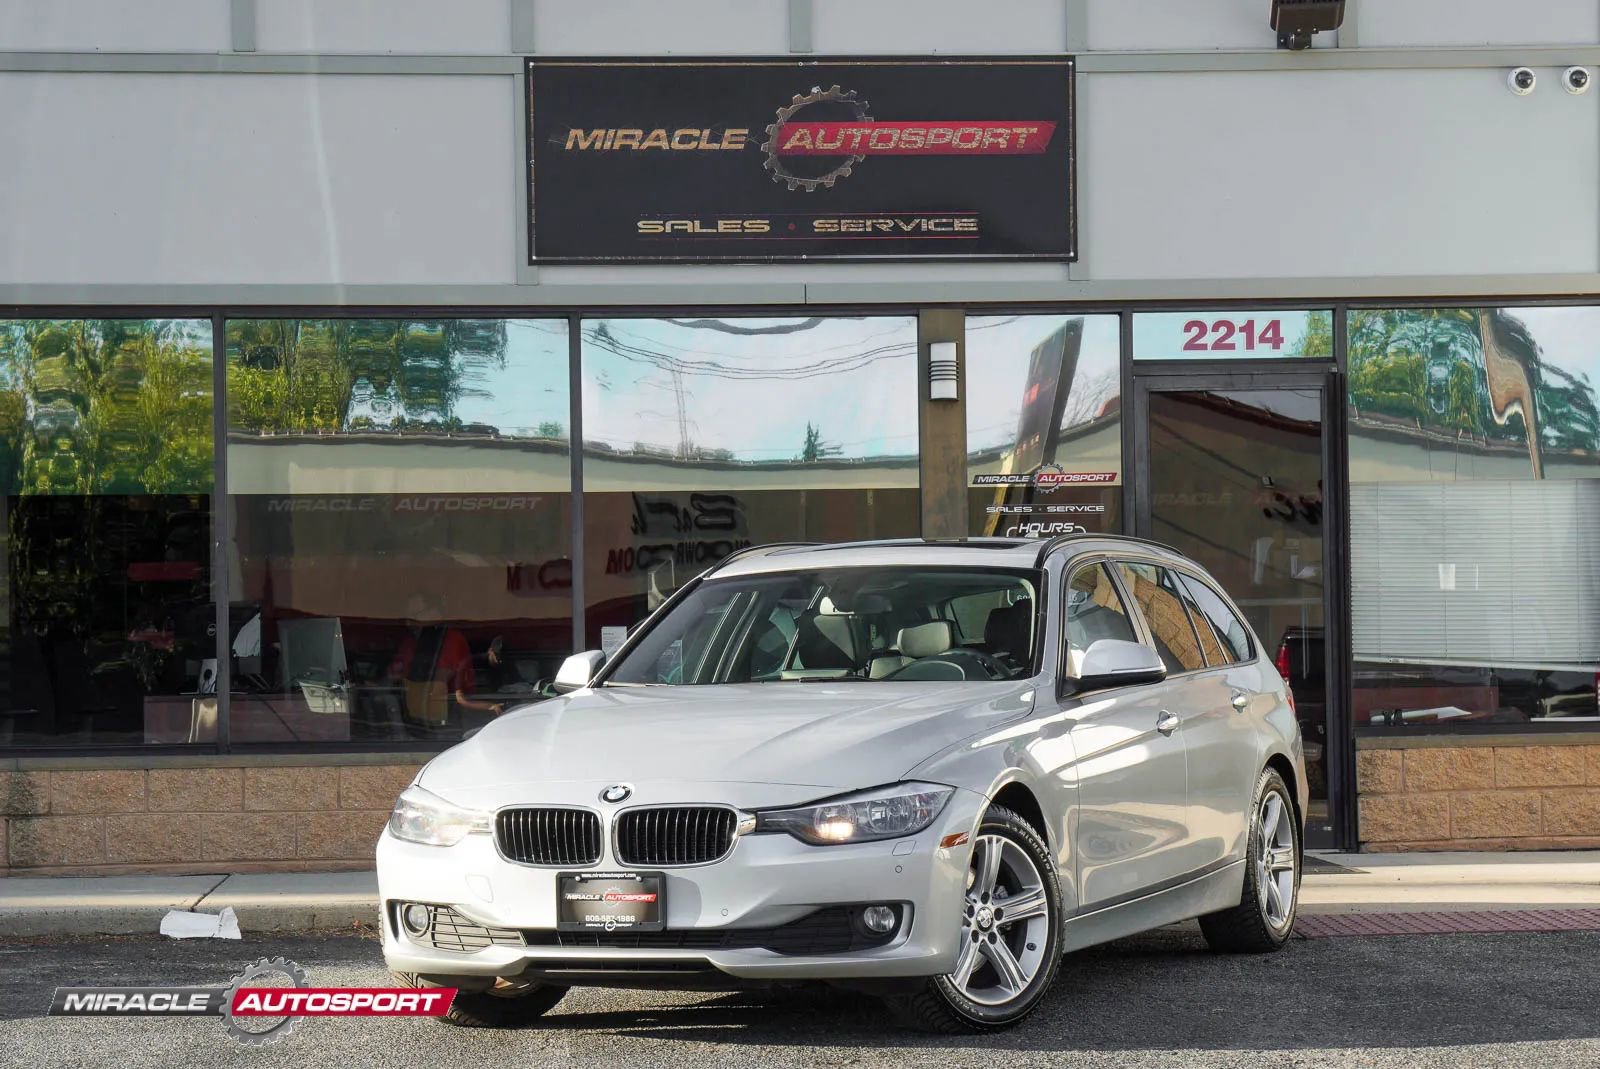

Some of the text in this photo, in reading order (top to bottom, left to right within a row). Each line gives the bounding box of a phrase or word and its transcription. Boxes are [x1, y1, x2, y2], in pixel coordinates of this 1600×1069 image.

[564, 127, 1039, 151] MIRACLE AUTOSPORT
[636, 217, 979, 233] SALES SERVICE
[1182, 319, 1285, 351] 2214
[977, 473, 1113, 483] MIRACLE AUTOSPORT
[267, 497, 542, 512] MIRACLE AUTOSPORT
[1018, 522, 1075, 534] HOURS
